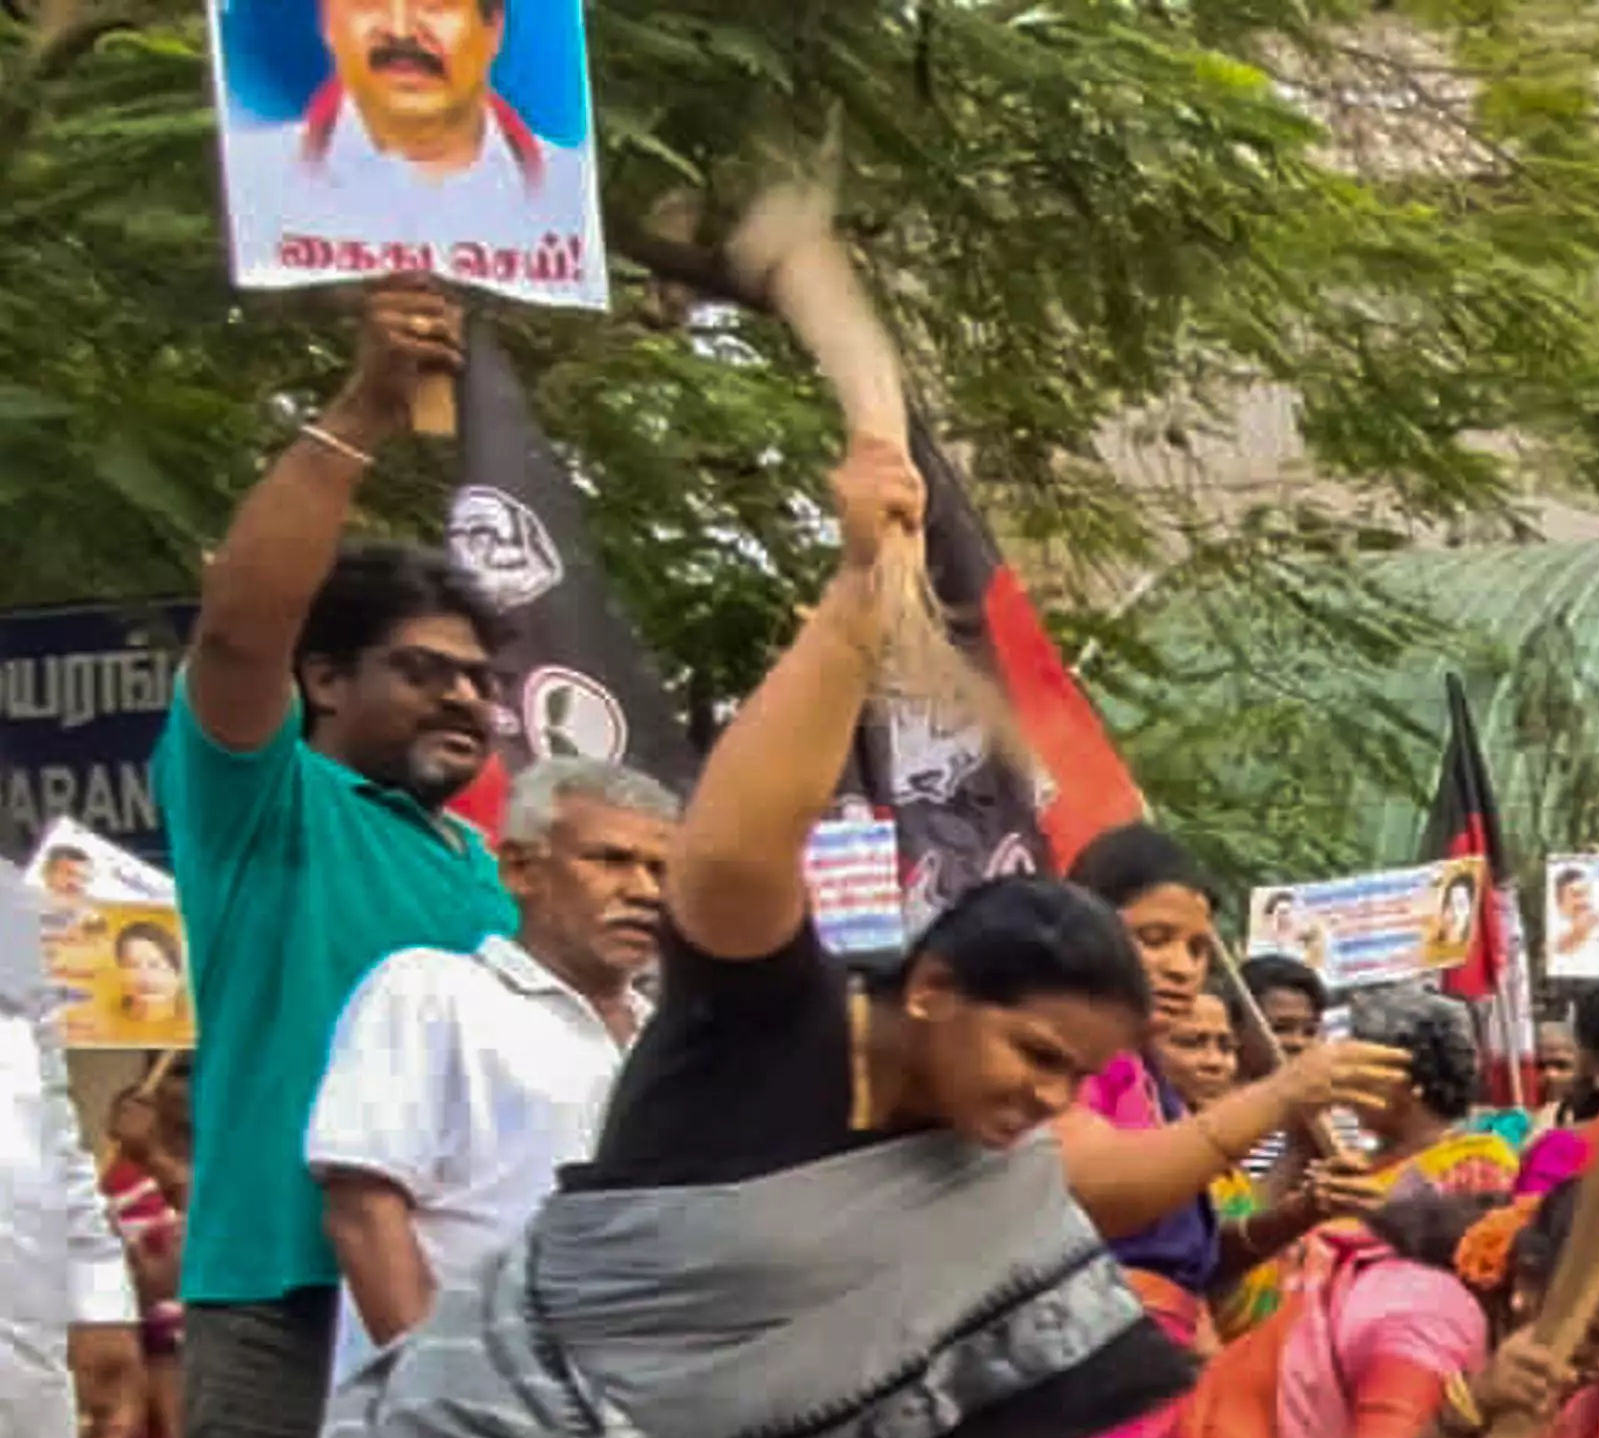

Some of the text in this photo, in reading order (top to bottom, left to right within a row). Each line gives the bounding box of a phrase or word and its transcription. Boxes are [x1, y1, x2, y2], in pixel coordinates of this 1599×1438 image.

[279, 231, 582, 281] கைது செய்!
[0, 630, 168, 730] யரங்
[0, 761, 158, 832] ARAN
